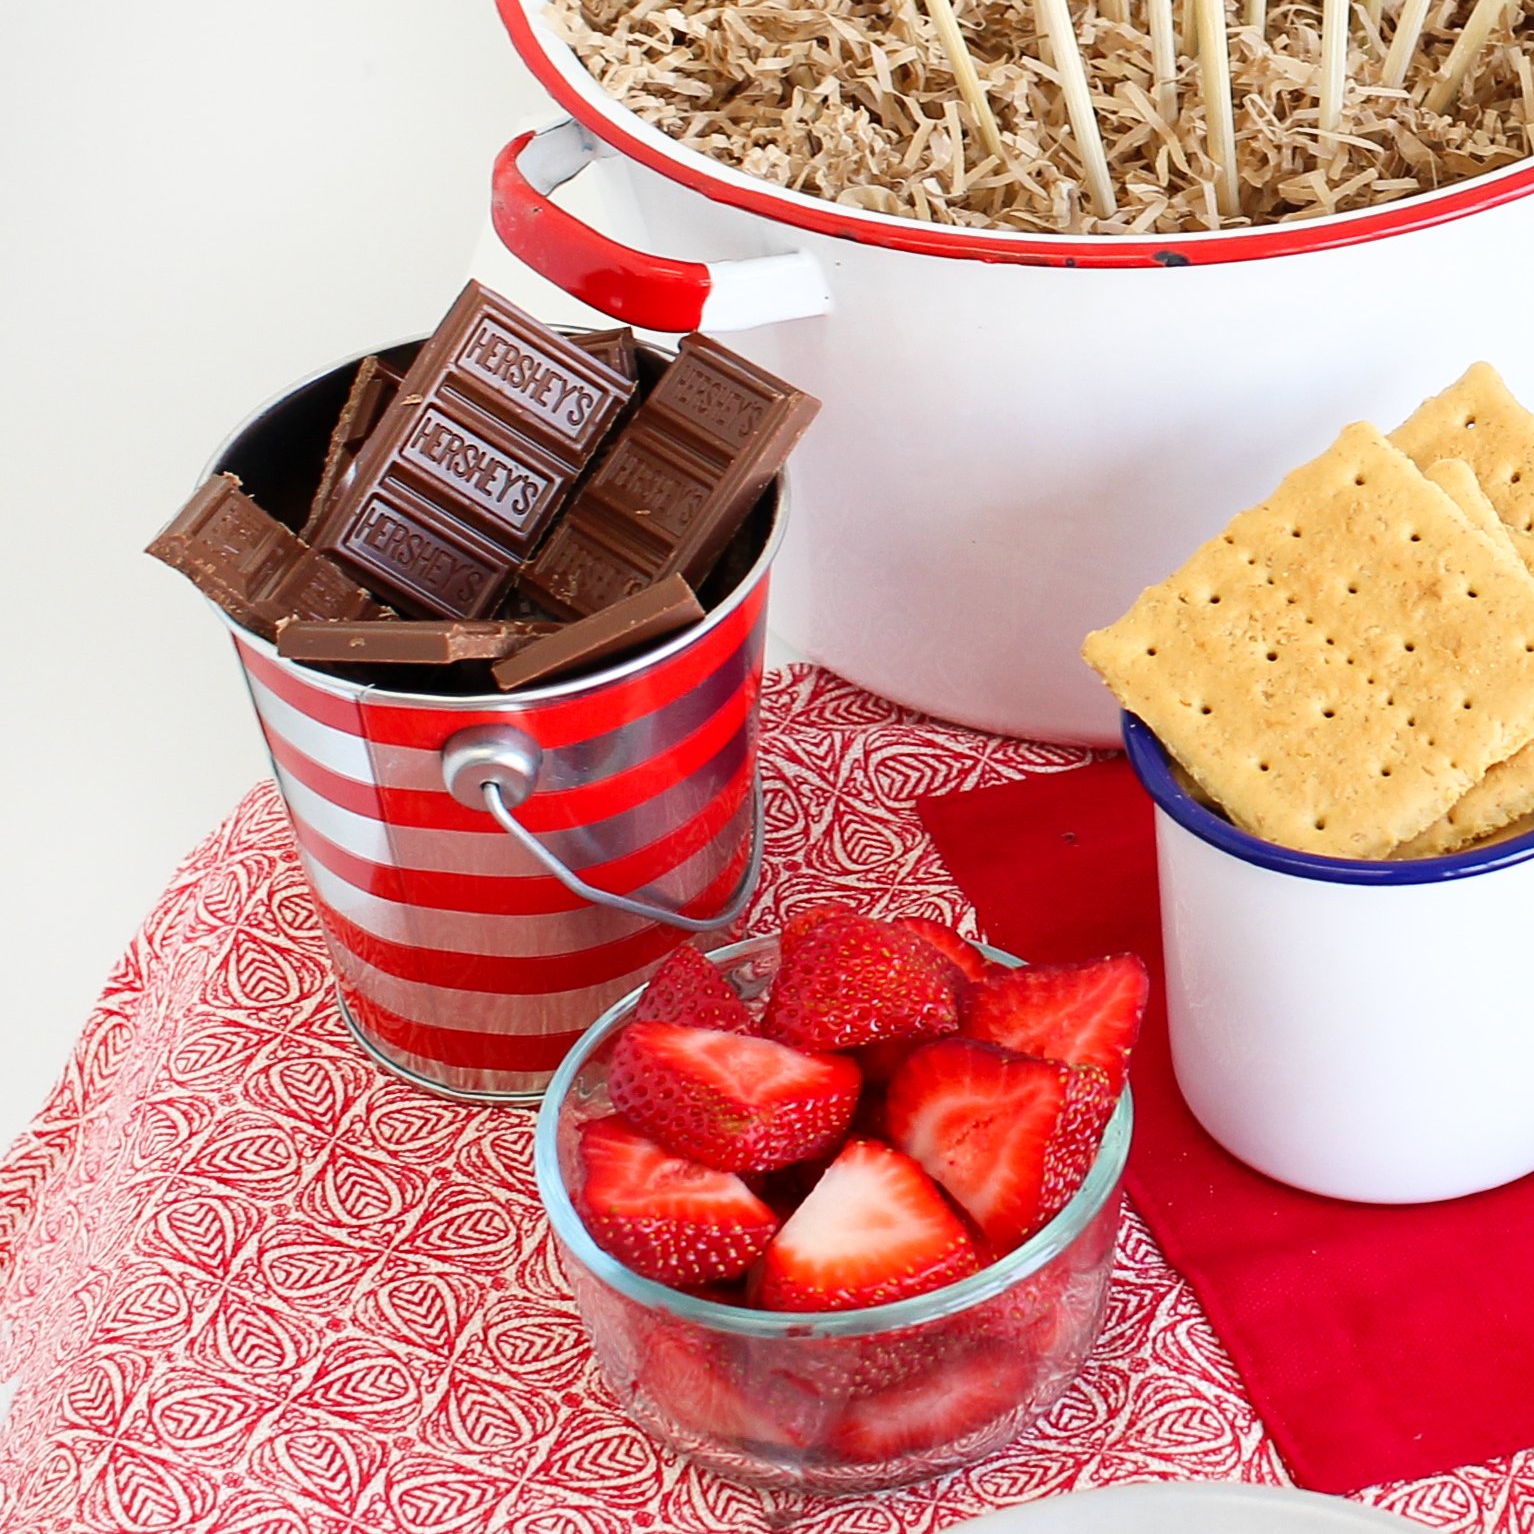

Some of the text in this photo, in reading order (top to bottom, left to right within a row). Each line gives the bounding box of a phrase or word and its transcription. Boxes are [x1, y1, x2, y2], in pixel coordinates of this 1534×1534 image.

[465, 325, 595, 427] HERSHEY'S
[675, 362, 764, 439] HERSHEY'S
[409, 415, 540, 516] HERSHEY'S
[353, 505, 485, 603] HERSHEY'S
